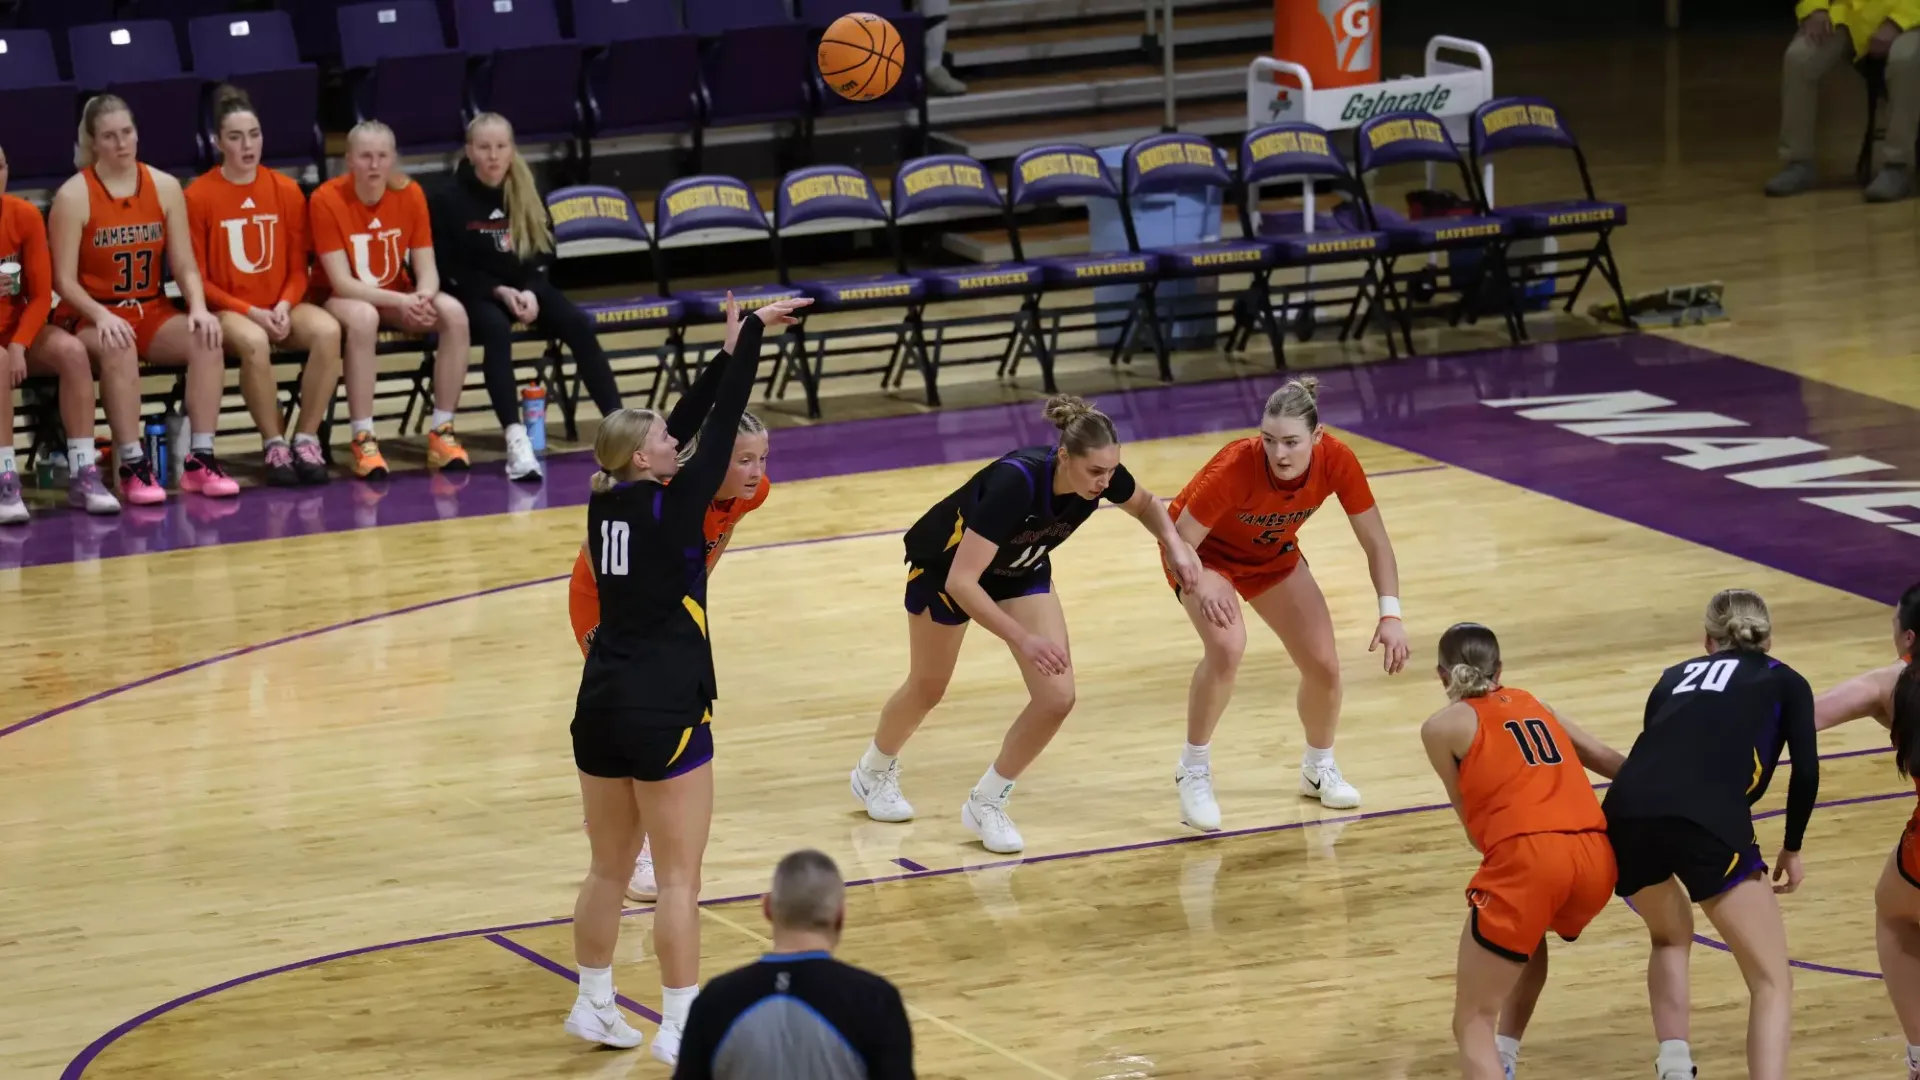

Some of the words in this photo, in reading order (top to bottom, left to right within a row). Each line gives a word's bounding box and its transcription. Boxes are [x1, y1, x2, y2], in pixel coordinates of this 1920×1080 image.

[1341, 1, 1369, 38] G
[1341, 84, 1451, 120] Gatorade
[1549, 208, 1615, 226] MAVERICKS
[220, 214, 279, 274] U
[350, 229, 402, 287] U
[1192, 250, 1262, 266] MAVERICKS
[1308, 237, 1376, 254] MAVERICKS
[113, 248, 153, 293] 33
[958, 272, 1028, 290] MAVERICKS
[1076, 261, 1146, 278] MAVERICKS
[839, 284, 910, 300] MAVERICKS
[595, 306, 669, 324] MAVERICKS
[1480, 390, 1920, 537] MAVE
[601, 520, 630, 575] 10
[1251, 528, 1286, 545] 5
[1008, 545, 1048, 568] 11
[1672, 659, 1739, 695] 20
[1504, 719, 1563, 766] 10
